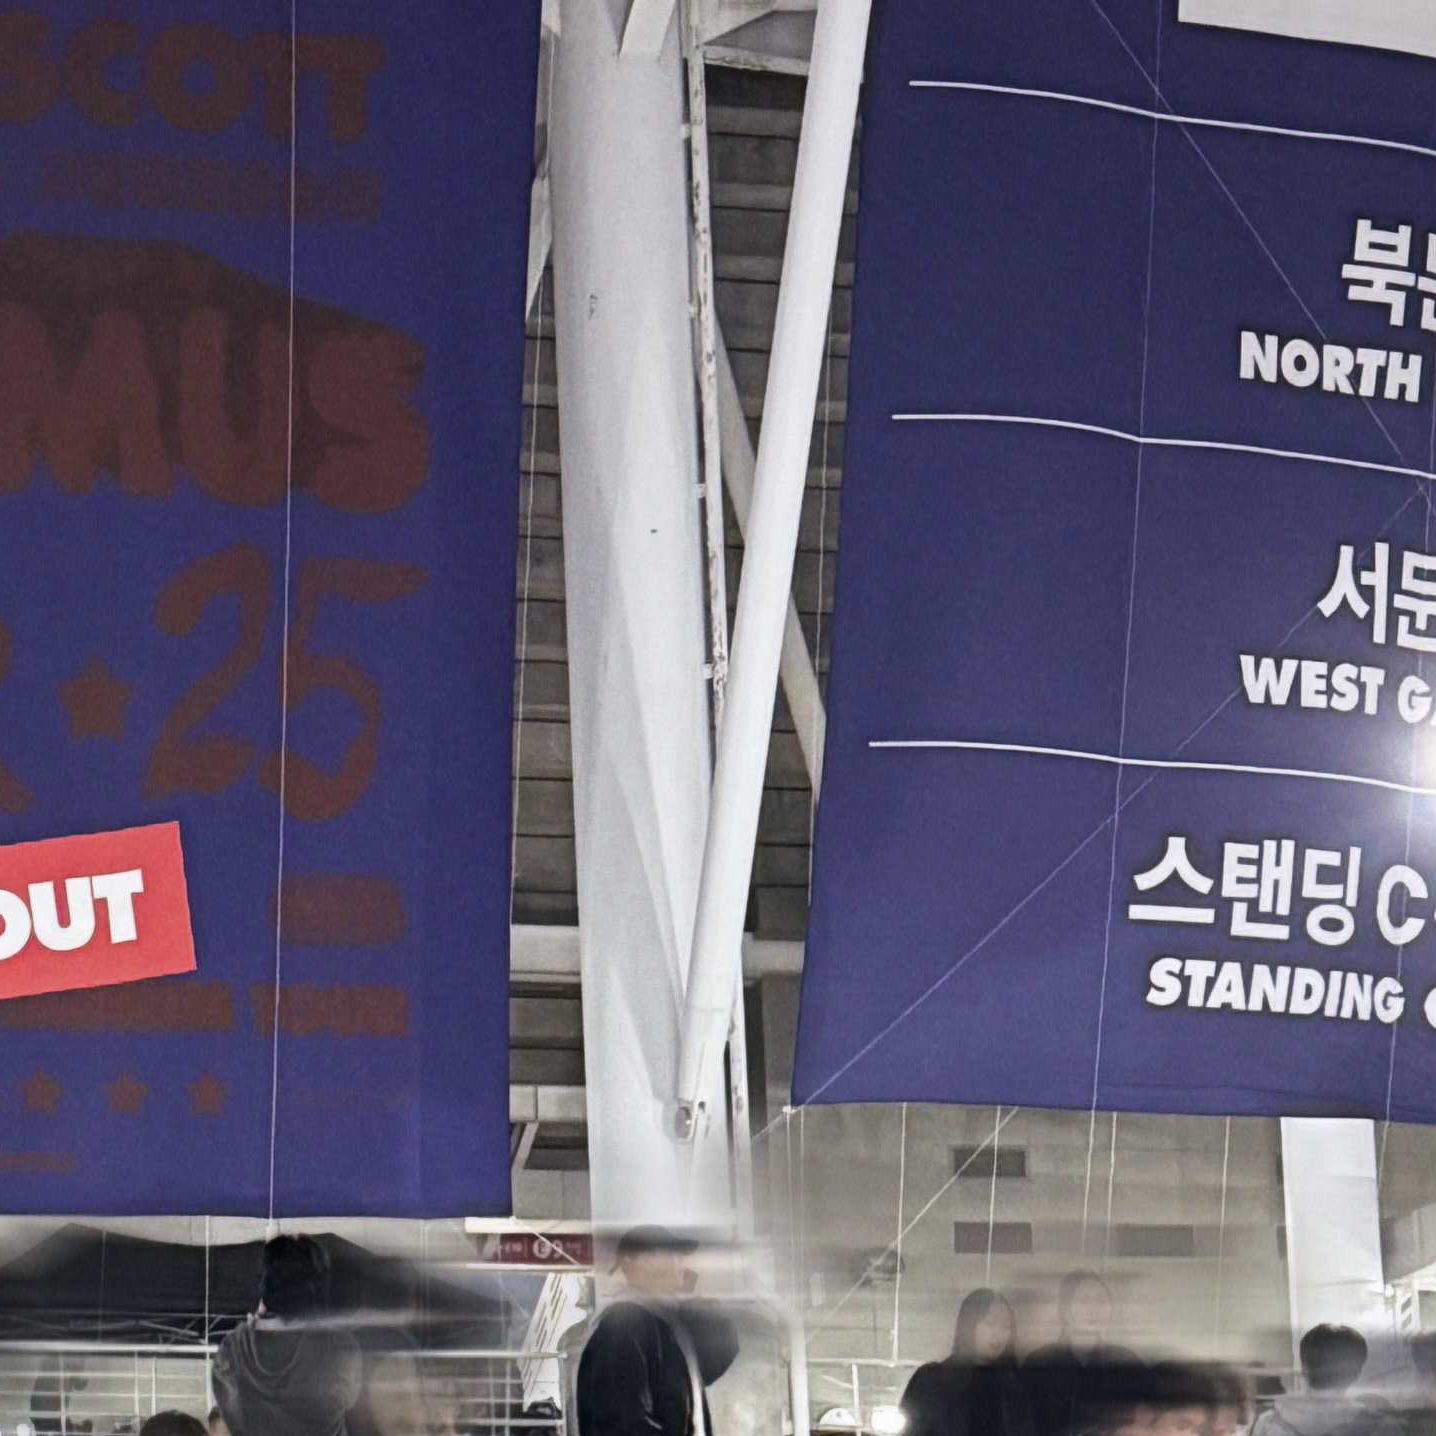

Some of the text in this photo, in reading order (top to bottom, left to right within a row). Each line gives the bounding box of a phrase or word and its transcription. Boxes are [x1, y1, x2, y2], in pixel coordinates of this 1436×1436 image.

[1341, 219, 1436, 333] 북
[1240, 330, 1422, 403] NORTH
[139, 544, 429, 820] 25
[1239, 654, 1436, 726] WEST G
[1146, 957, 1405, 1023] STANDING
